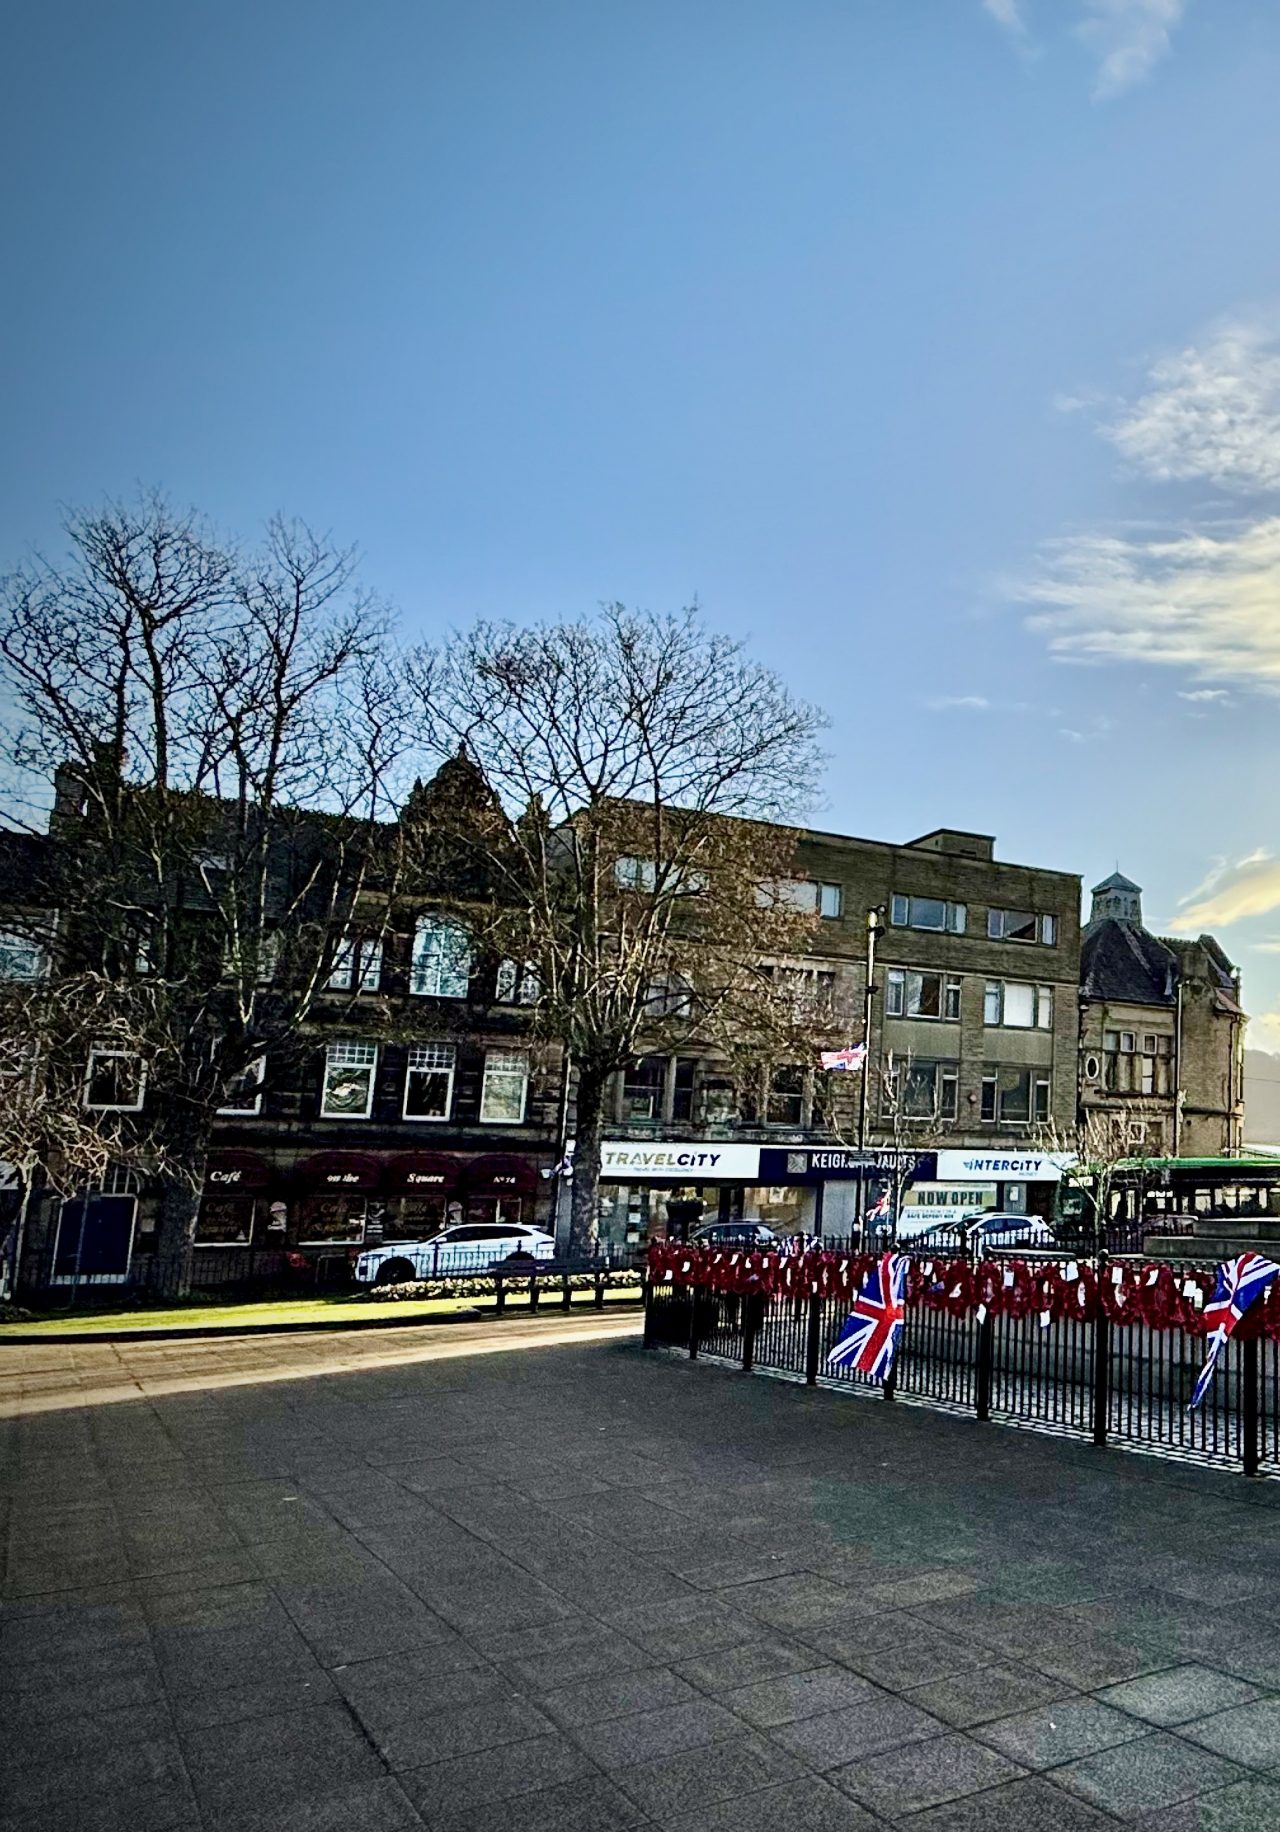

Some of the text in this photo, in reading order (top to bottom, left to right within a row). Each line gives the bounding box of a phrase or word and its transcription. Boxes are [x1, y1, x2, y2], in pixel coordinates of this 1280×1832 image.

[968, 1158, 1042, 1172] INTERCITY
[209, 1170, 242, 1184] Café
[407, 1173, 445, 1185] Square
[917, 1191, 983, 1206] NOW OPEN
